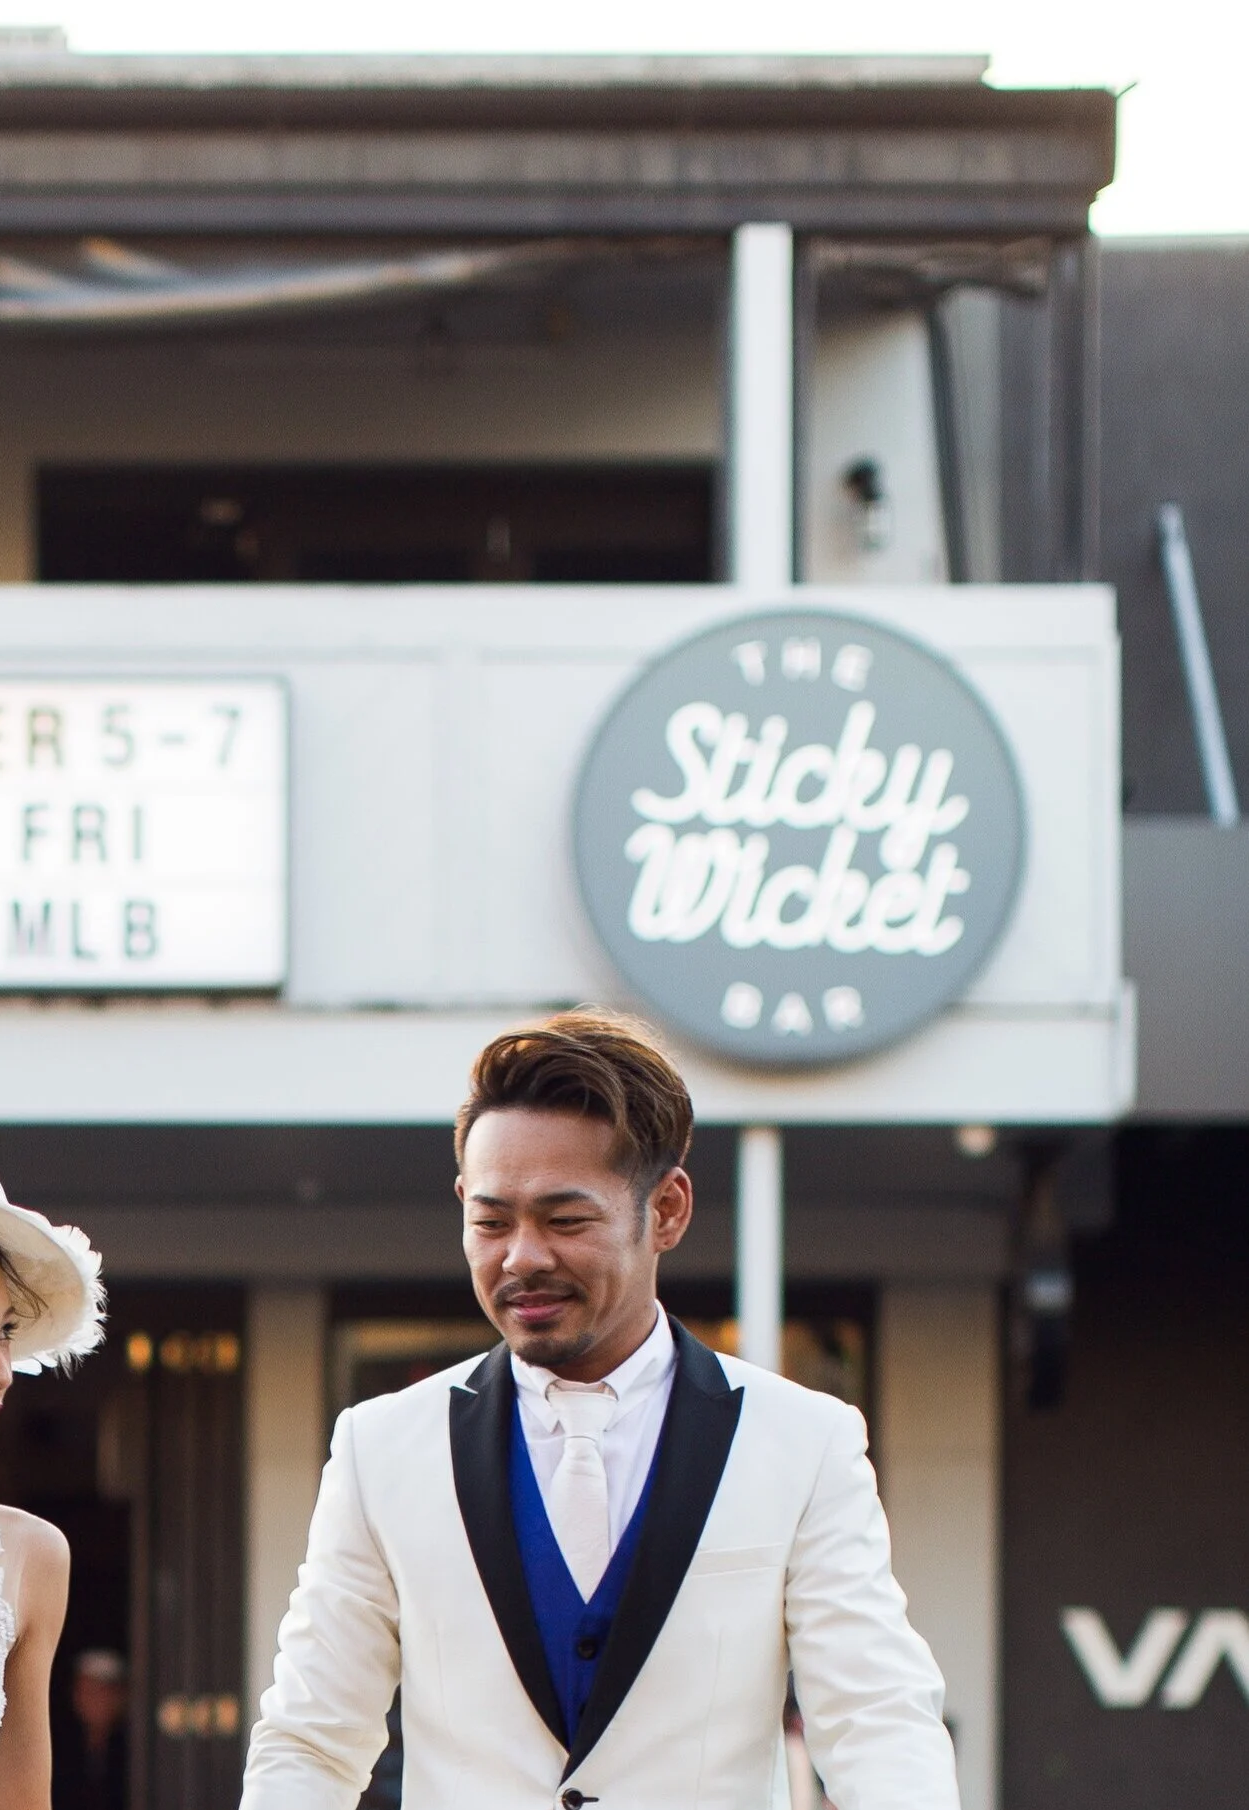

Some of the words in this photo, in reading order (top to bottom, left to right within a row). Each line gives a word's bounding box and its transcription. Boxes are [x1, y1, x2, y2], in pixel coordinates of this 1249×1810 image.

[732, 636, 874, 692] THE
[102, 703, 243, 769] 5-7
[631, 700, 970, 872] Sticky
[21, 802, 145, 864] FRI
[625, 822, 972, 957] Wicket
[7, 898, 159, 961] MLB
[721, 982, 864, 1036] BAR
